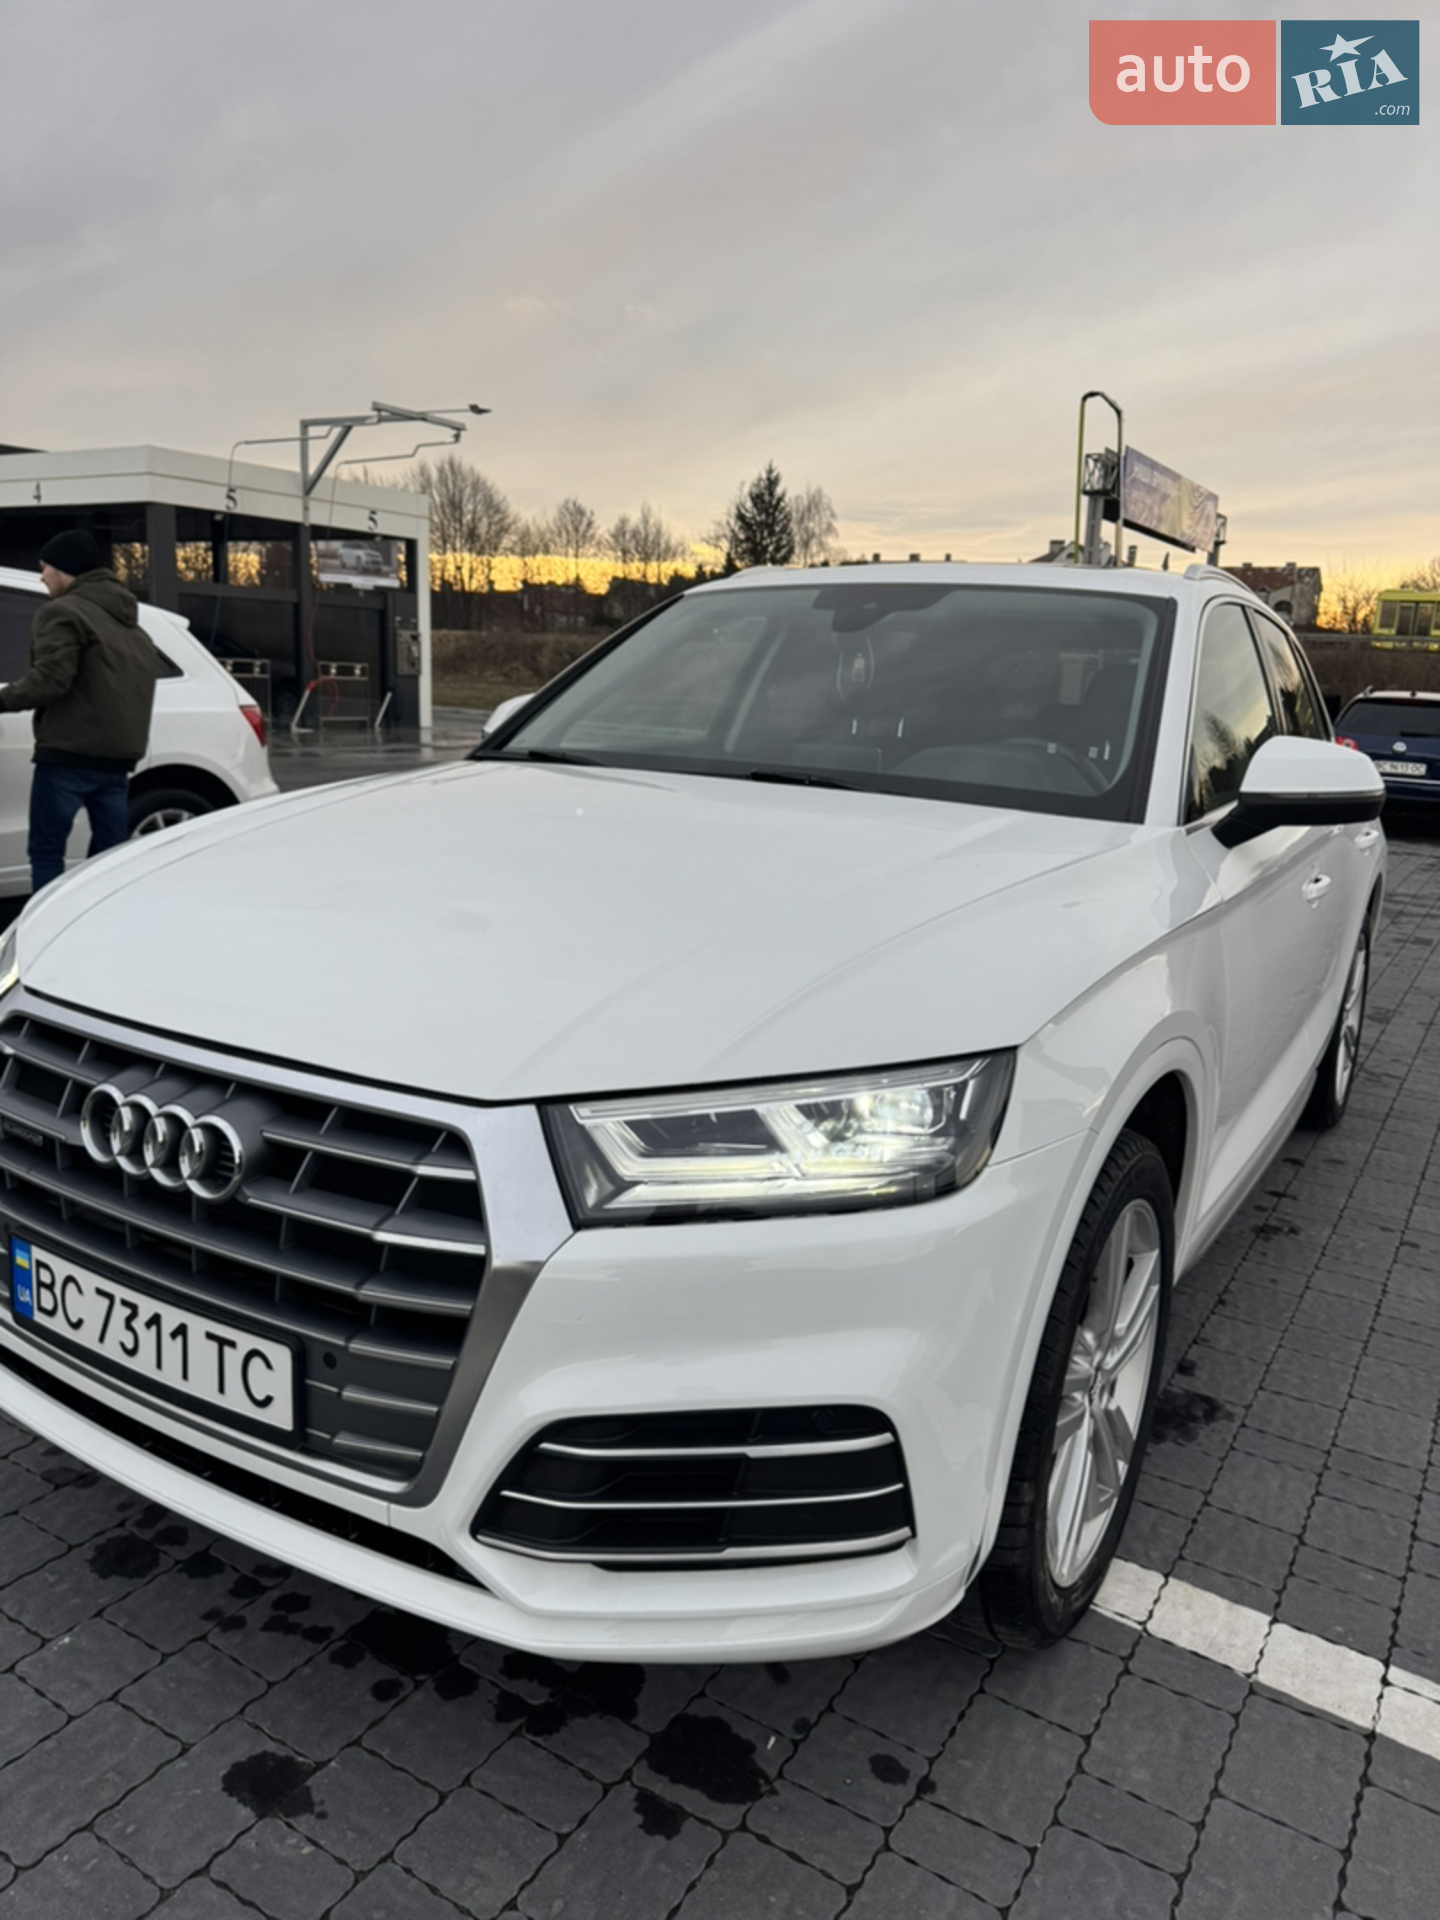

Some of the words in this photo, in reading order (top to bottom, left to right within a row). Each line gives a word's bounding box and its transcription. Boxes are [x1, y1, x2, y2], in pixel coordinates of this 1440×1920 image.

[32, 482, 42, 504] 4
[225, 488, 238, 511] 5
[367, 510, 379, 532] 5
[17, 1284, 32, 1305] UA
[35, 1259, 84, 1331] BC
[95, 1287, 189, 1382] 7311
[205, 1331, 275, 1409] TC
